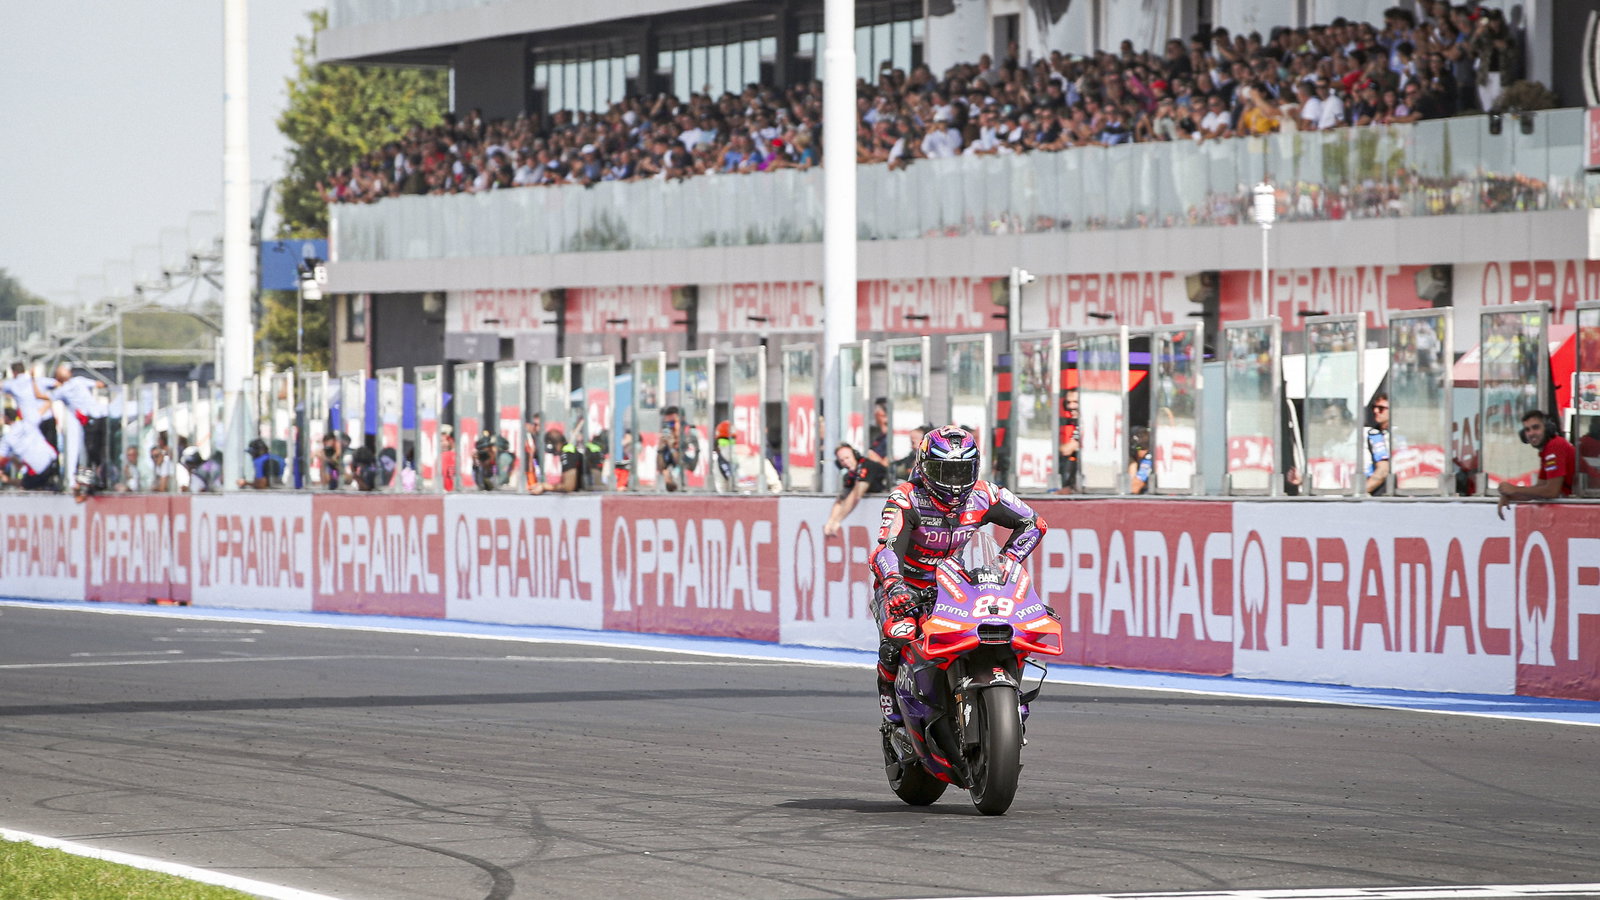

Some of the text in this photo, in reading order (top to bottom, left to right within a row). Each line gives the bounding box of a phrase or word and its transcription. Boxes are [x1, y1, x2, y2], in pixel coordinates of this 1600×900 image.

[887, 277, 983, 329] PRAMAC
[1066, 270, 1175, 326] PRAMAC
[1272, 265, 1401, 327] PRAMAC
[7, 514, 78, 578] PRAMAC
[104, 513, 187, 584] PRAMAC
[216, 515, 304, 588] PRAMAC
[336, 514, 440, 595] PRAMAC
[477, 517, 593, 601] PRAMAC
[635, 517, 772, 613] PRAMAC
[935, 603, 969, 618] prima
[972, 594, 1015, 618] 89
[1015, 603, 1043, 621] prima
[1042, 527, 1233, 643] PRAMAC
[1281, 536, 1511, 656] PRAMAC
